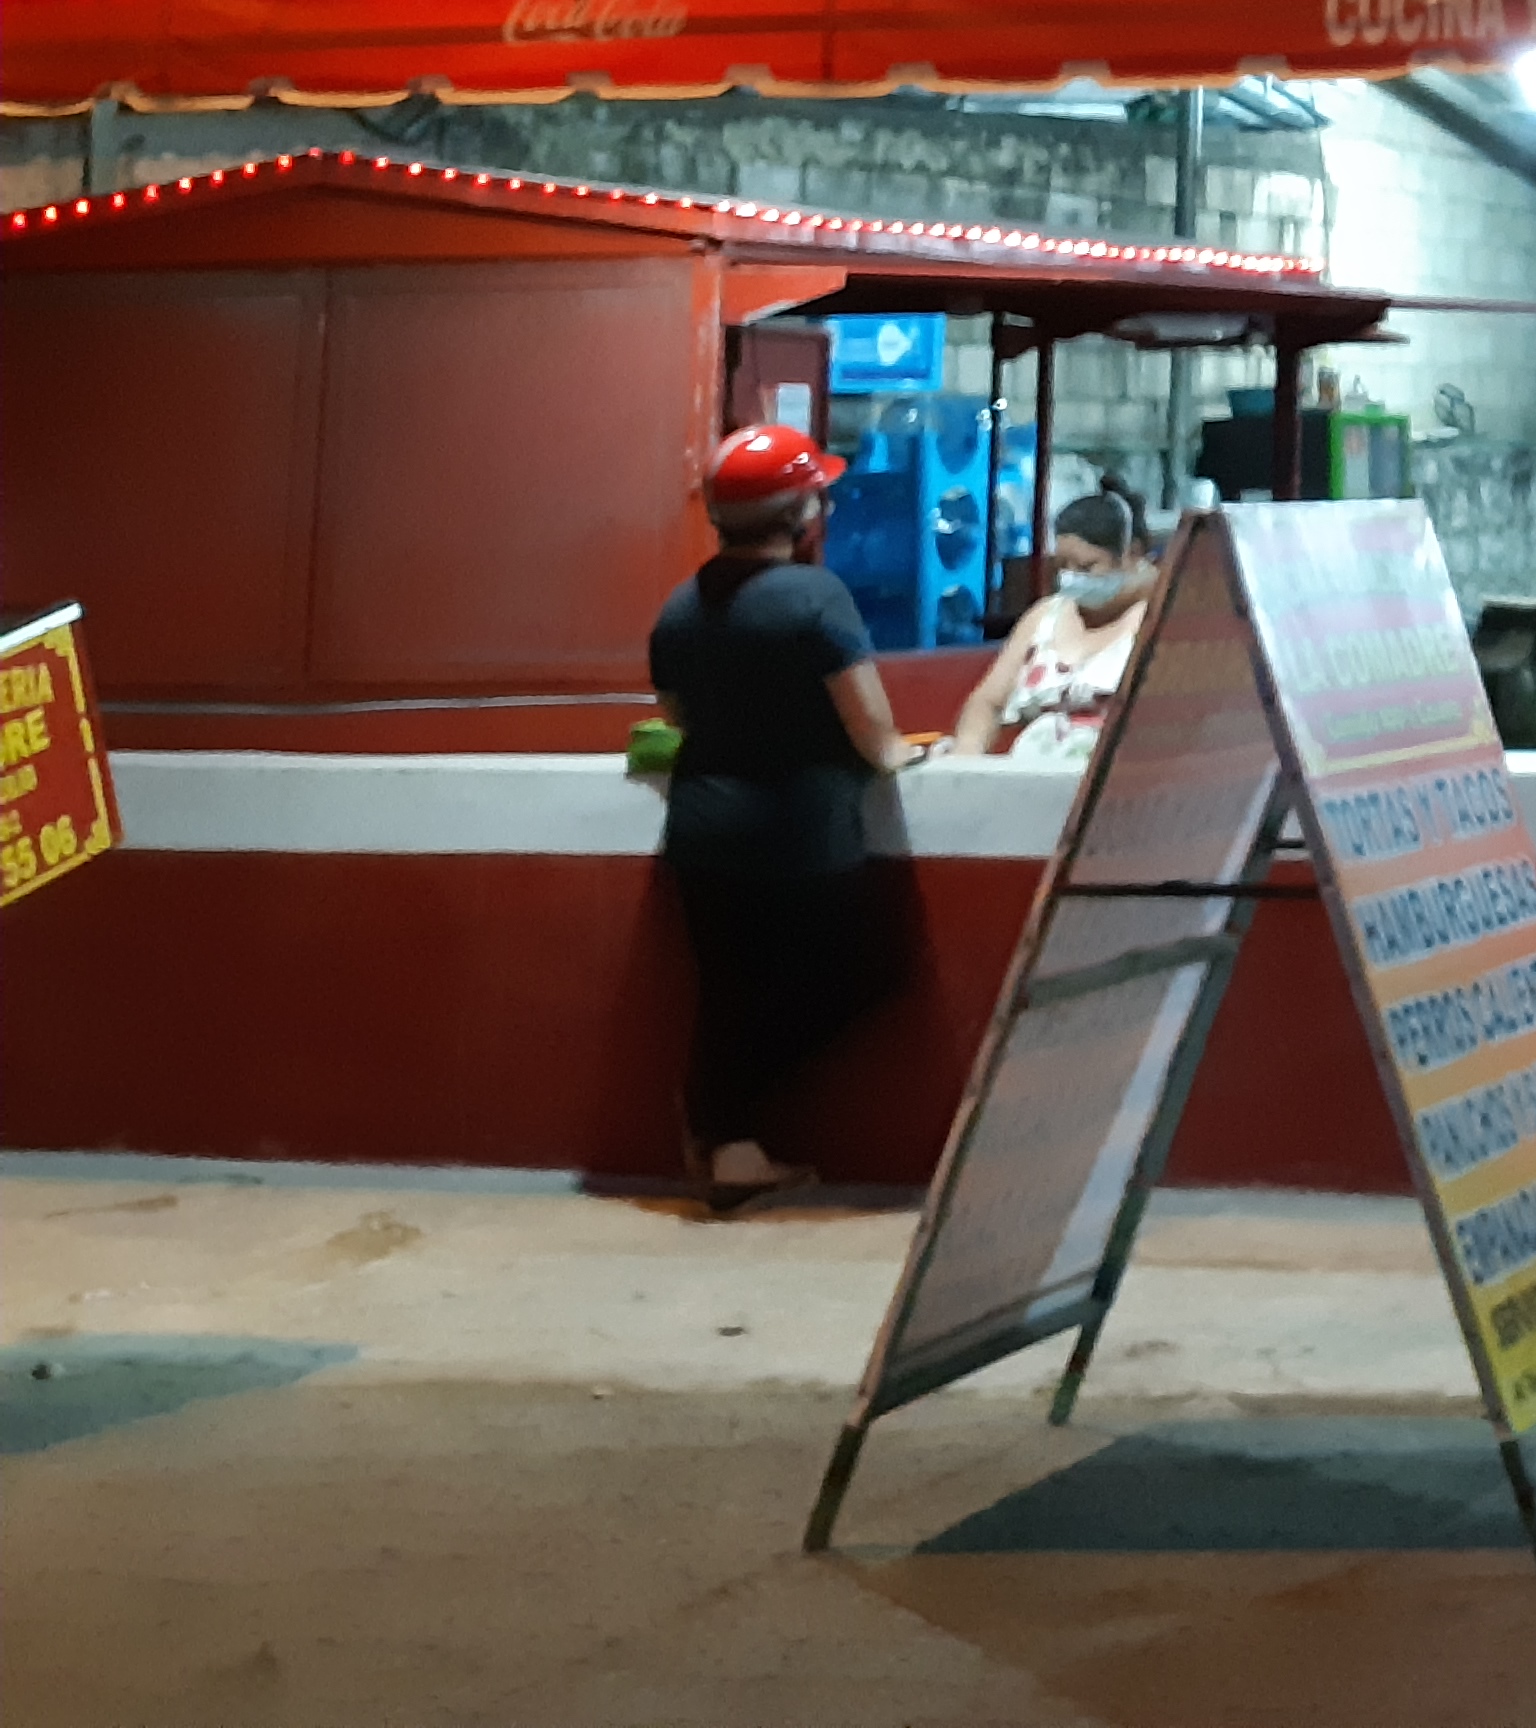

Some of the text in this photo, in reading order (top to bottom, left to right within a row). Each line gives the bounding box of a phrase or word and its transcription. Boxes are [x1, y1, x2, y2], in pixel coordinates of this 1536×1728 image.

[1321, 783, 1423, 863] TORTAS
[1431, 763, 1516, 836] TACOS
[1387, 983, 1480, 1071] PERROS
